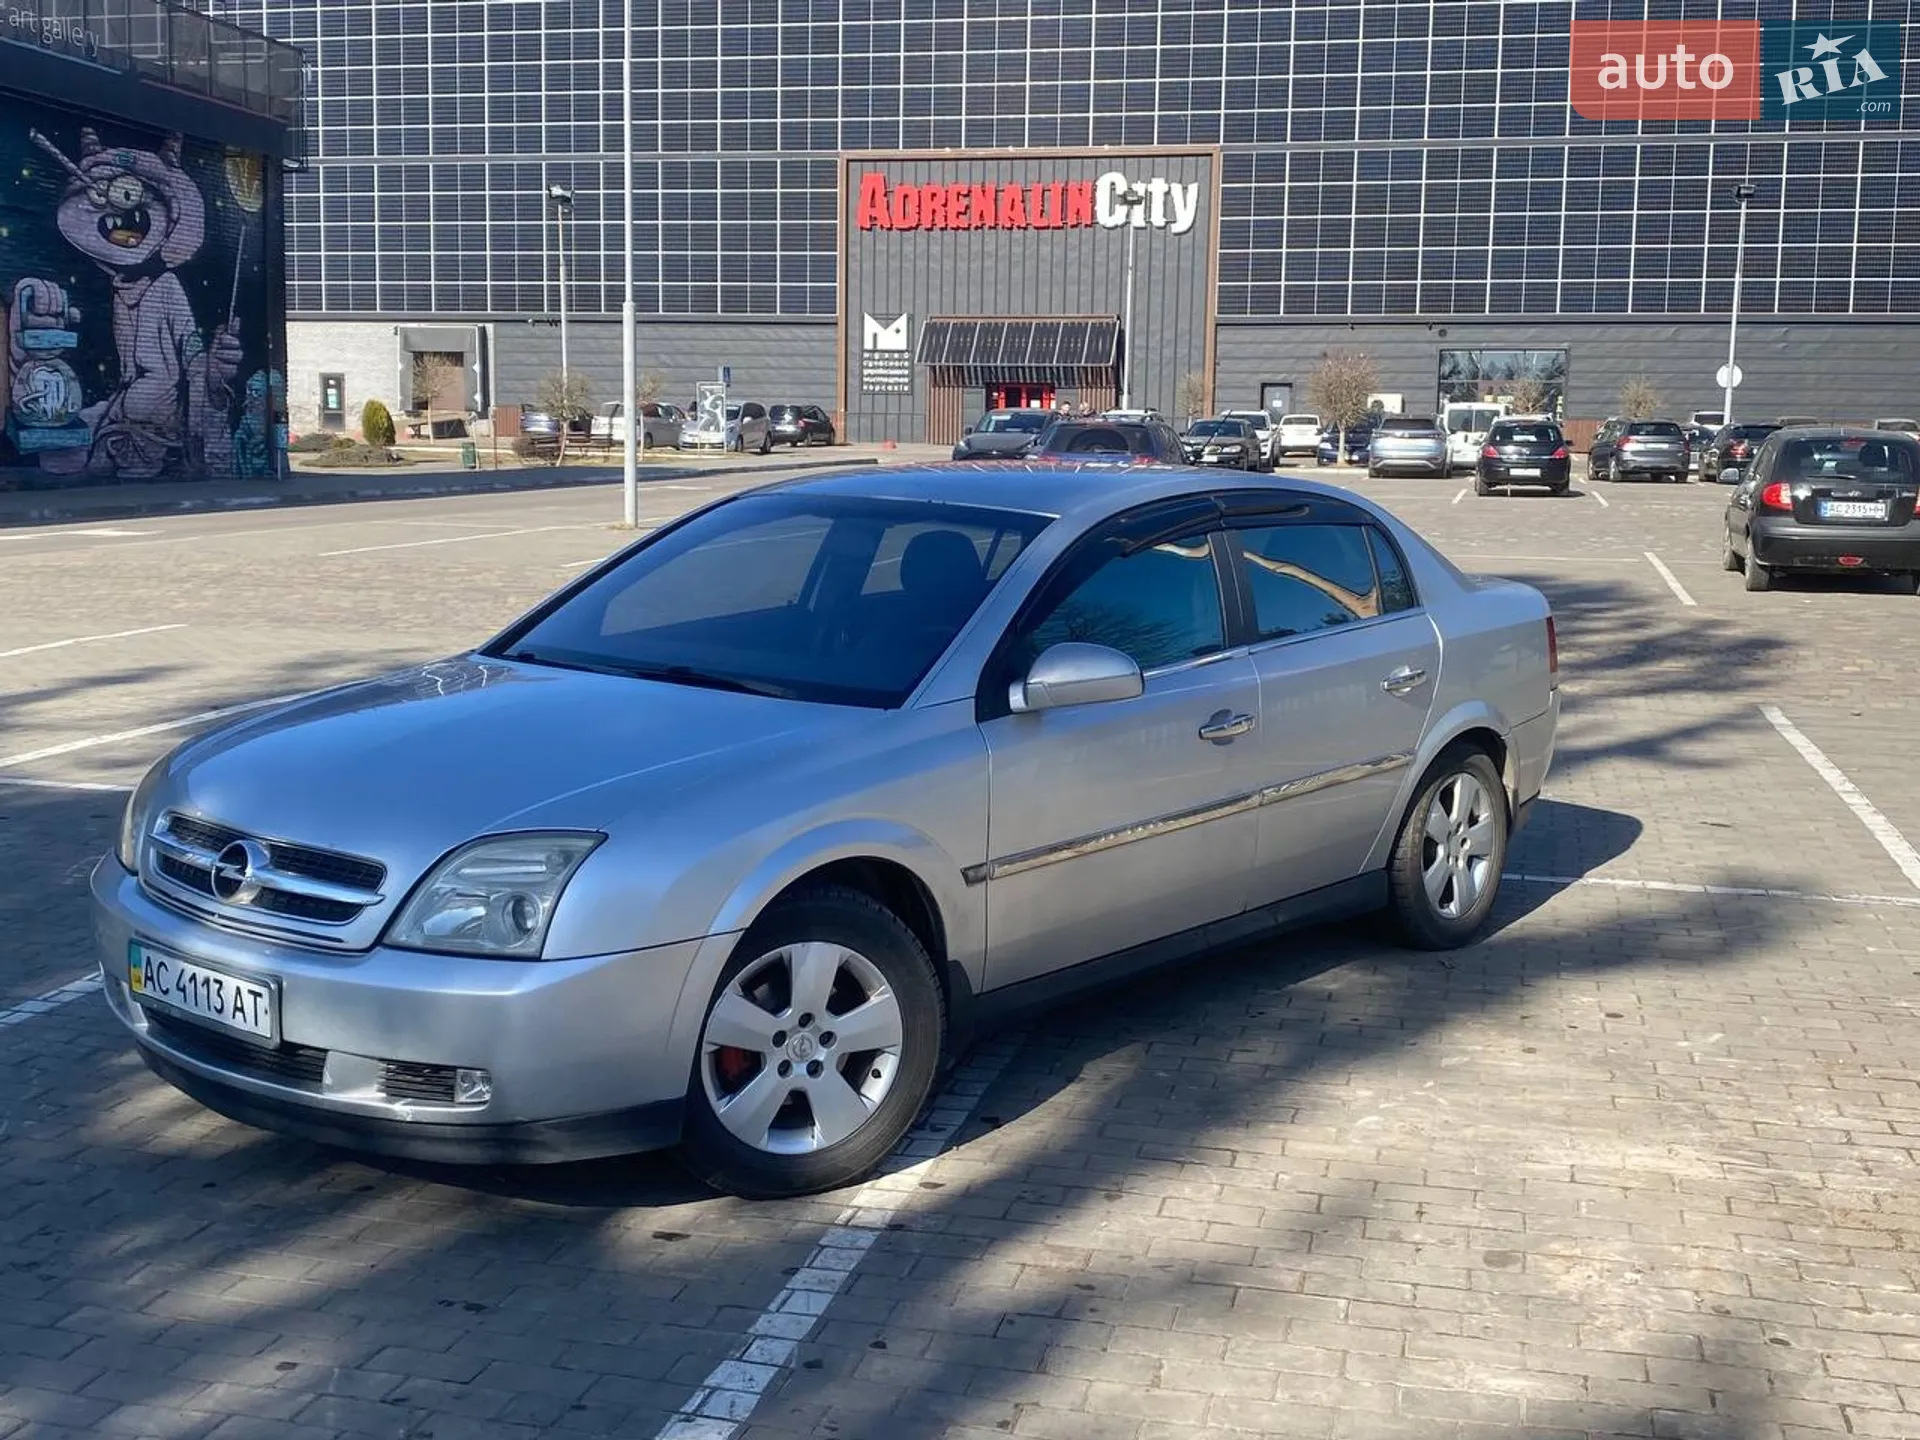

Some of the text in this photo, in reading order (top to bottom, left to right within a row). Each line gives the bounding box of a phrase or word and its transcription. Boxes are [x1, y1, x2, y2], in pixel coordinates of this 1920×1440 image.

[8, 6, 38, 33] art
[144, 955, 263, 1027] AC 4113 AT
